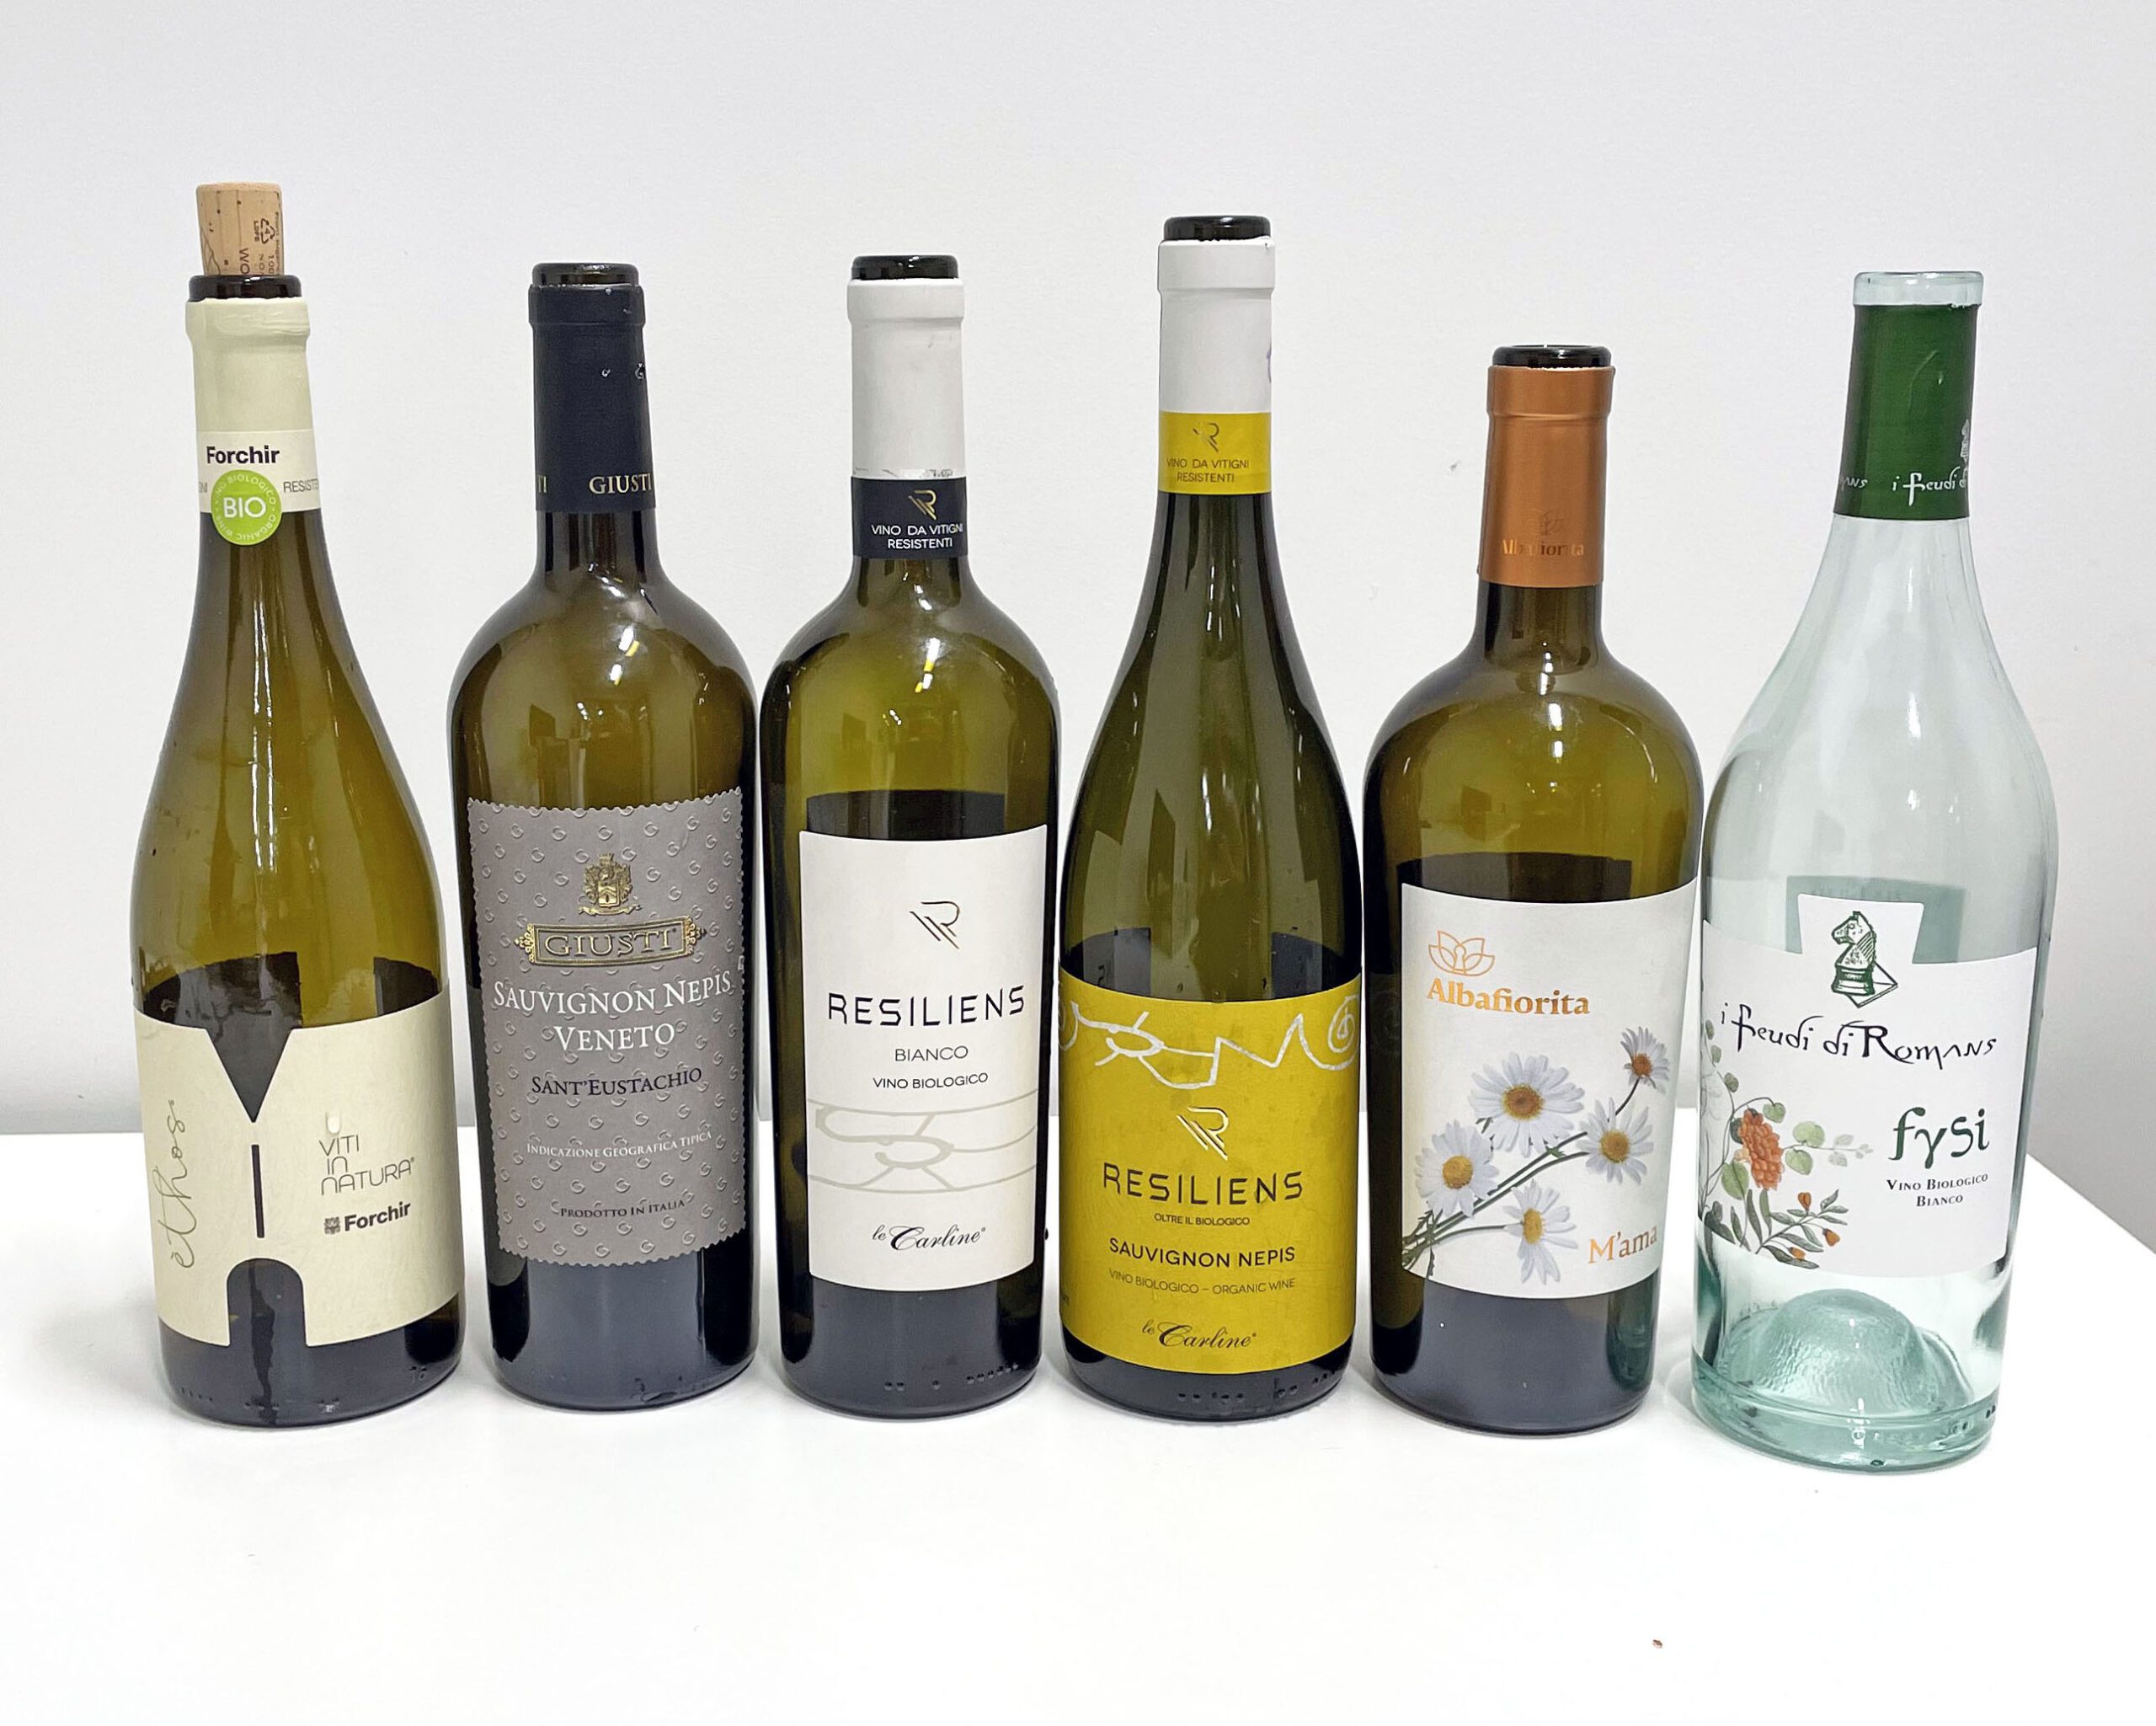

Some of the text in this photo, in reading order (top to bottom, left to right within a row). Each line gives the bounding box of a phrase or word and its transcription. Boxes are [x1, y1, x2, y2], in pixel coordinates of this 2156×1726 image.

[206, 445, 280, 464] Forchir
[1166, 457, 1250, 469] VINO DA VITIGNI
[227, 473, 277, 505] BIOLOGICO
[589, 473, 653, 494] GIUSTI
[1177, 472, 1235, 483] RESISTENTI
[222, 496, 267, 519] BIO
[237, 514, 276, 541] ORGANIC
[871, 524, 902, 536] VINO
[907, 525, 927, 536] DA
[887, 537, 953, 549] RESISTENTI
[543, 927, 677, 956] GIUSTI
[493, 970, 732, 1014] SAUVIGNON NEPIS
[1428, 976, 1591, 1015] Albafiorita
[828, 984, 1025, 1027] RESILIENS
[552, 1021, 675, 1051] VENETO
[1731, 1003, 1824, 1053] feudi
[1822, 1020, 1865, 1056] di
[894, 1045, 969, 1062] BIANCO
[873, 1071, 989, 1089] VINO BIOLOGICO
[318, 1134, 360, 1157] VITI
[526, 1130, 712, 1158] INDICAZIONE GEOGRAFICA TIPICA
[1887, 1106, 1990, 1169] fysi
[1103, 1162, 1304, 1205] RESILIENS
[1886, 1173, 1988, 1191] VINO BIOLOGICO
[560, 1208, 627, 1218] PRODOTTO
[648, 1200, 686, 1214] ITALIA
[1916, 1194, 1963, 1207] BIANCO
[344, 1200, 411, 1232] Forchir
[1154, 1212, 1251, 1226] OLTRE IL BIOLOGICO
[872, 1224, 887, 1242] le
[1588, 1225, 1657, 1264] M'ama
[1108, 1237, 1296, 1268] SAUVIGNON NEPIS
[1108, 1268, 1134, 1285] VINO
[1135, 1275, 1199, 1294] BIOLOGICO
[1212, 1282, 1267, 1295] ORGANIC
[1268, 1277, 1296, 1291] WINE
[1141, 1319, 1155, 1335] le
